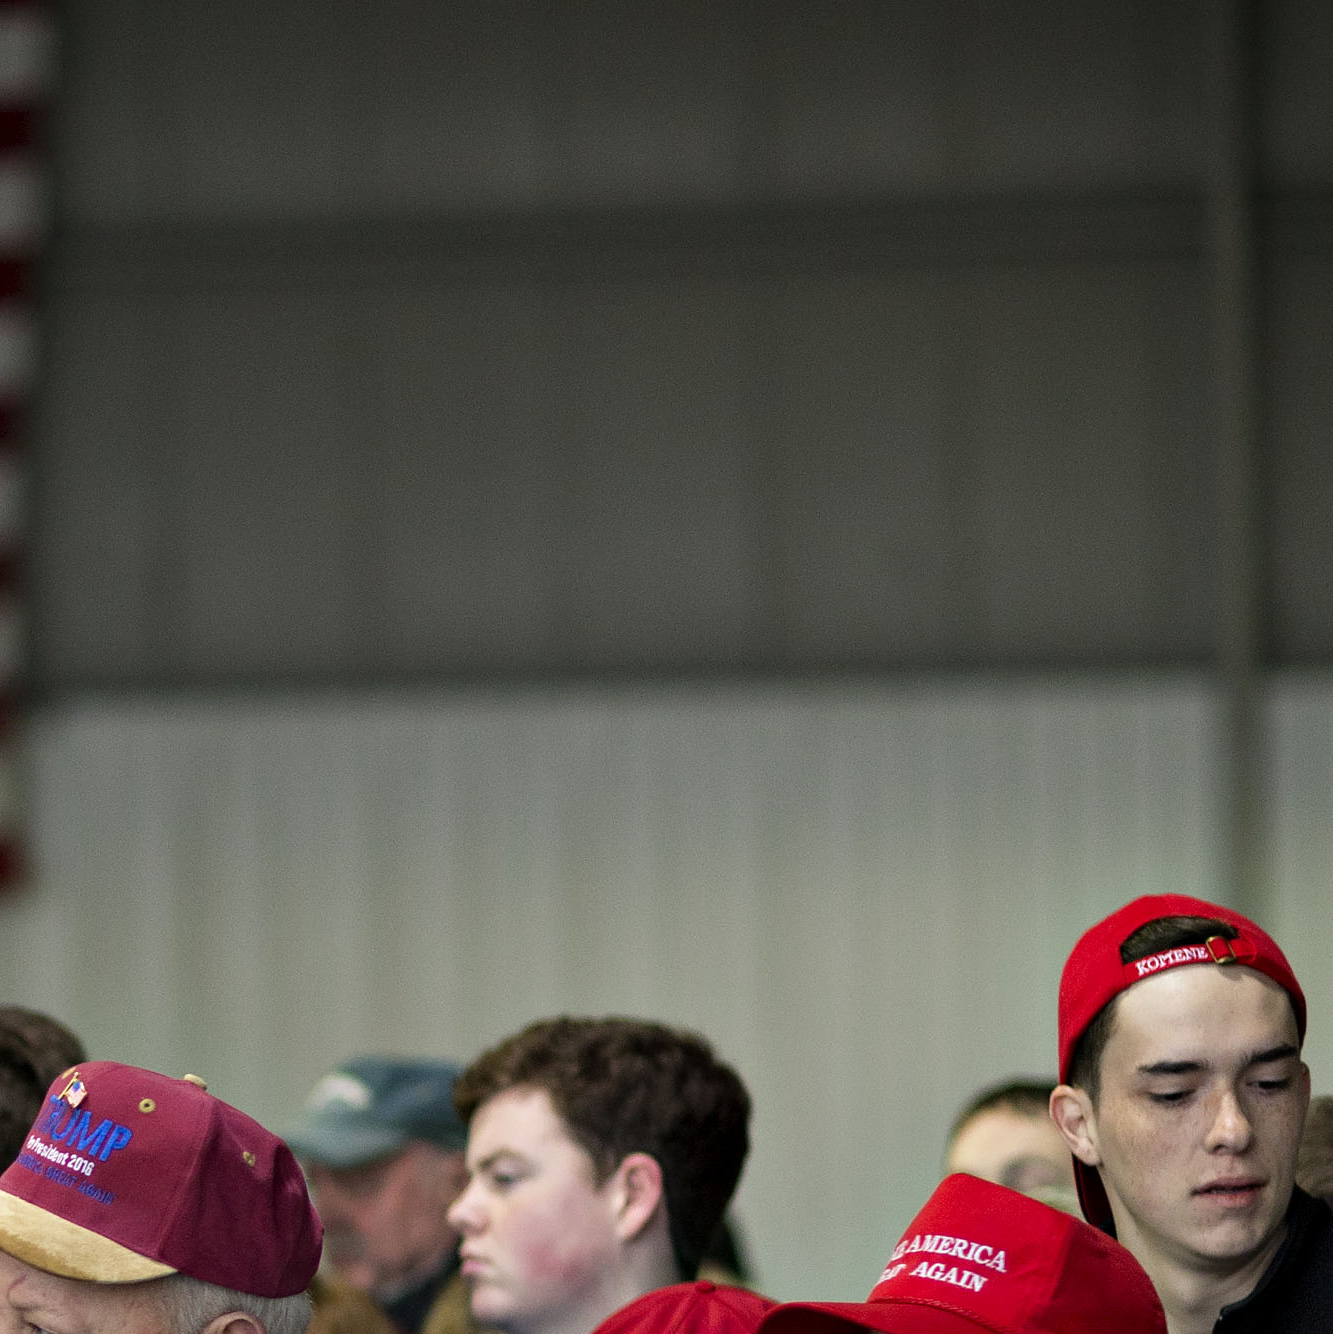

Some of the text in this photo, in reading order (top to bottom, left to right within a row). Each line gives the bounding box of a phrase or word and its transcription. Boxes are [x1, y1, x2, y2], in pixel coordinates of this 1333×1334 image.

[67, 1154, 95, 1176] 2016
[77, 1180, 118, 1205] AGAIN
[905, 1235, 1007, 1273] AMERICA
[909, 1261, 989, 1292] AGAIN
